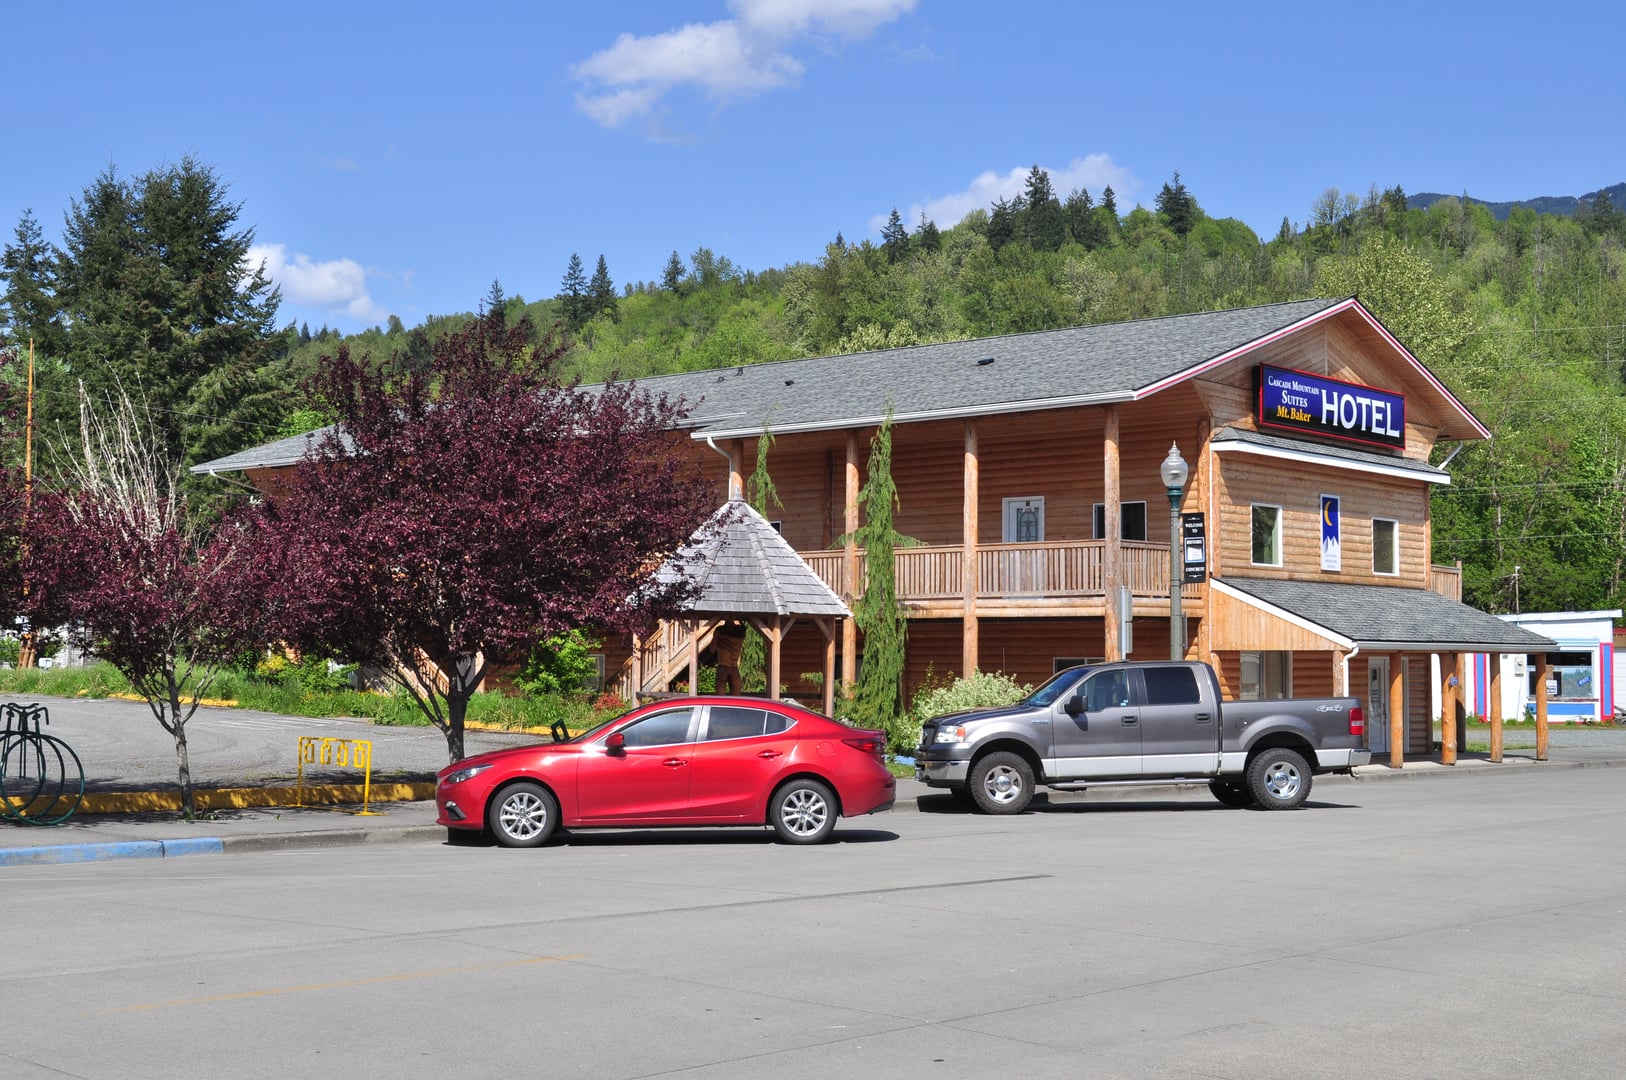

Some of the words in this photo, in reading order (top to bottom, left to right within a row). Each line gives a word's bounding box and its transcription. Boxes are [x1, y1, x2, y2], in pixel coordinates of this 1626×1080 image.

[1277, 405, 1290, 419] Mt.
[1290, 407, 1312, 423] Baker
[1321, 389, 1400, 438] HOTEL
